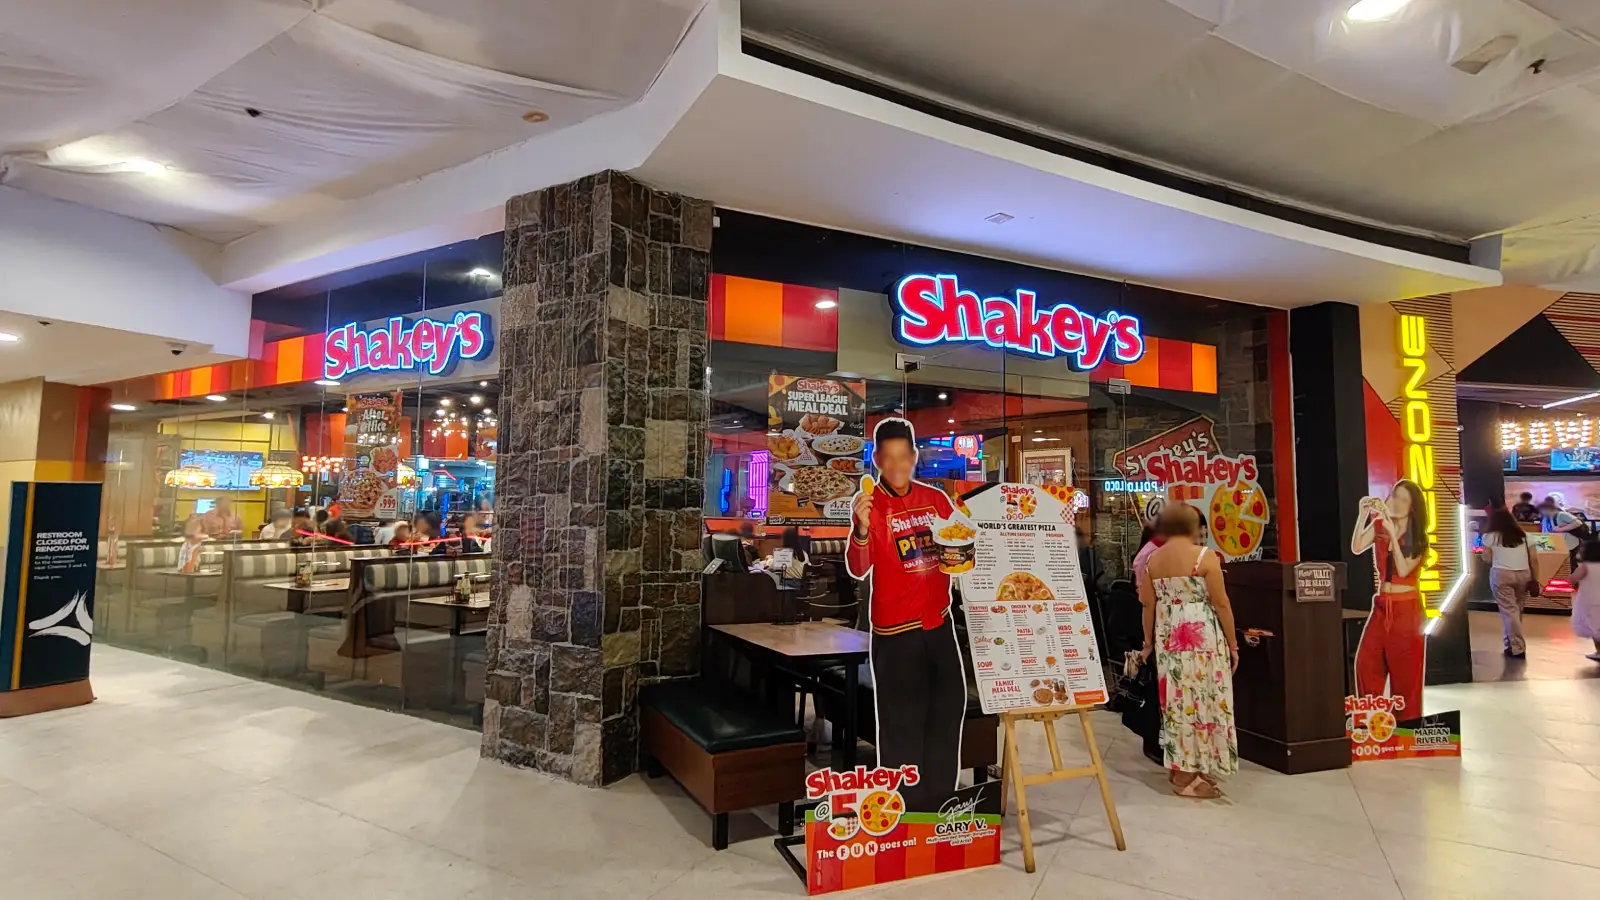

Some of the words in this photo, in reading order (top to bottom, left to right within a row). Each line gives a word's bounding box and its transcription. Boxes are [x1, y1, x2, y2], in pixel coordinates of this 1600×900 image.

[897, 274, 1143, 369] Shakey's
[324, 311, 484, 380] Shakey's
[797, 380, 840, 394] Shakey's
[787, 390, 815, 402] SUPER
[816, 393, 848, 404] LEAGUE
[787, 400, 819, 413] MEAL
[820, 402, 848, 415] DEAL
[1144, 453, 1258, 489] Shakey's
[1000, 485, 1035, 499] Shakey's
[977, 522, 1007, 530] WORLD'S
[1008, 523, 1037, 531] GREATEST
[1038, 524, 1056, 532] PIZZA
[1312, 569, 1330, 578] WAIT
[1414, 728, 1450, 736] MARIAN
[1416, 736, 1447, 744] RIVERA
[805, 764, 920, 800] Shakey's
[974, 819, 987, 829] V.
[816, 849, 834, 860] The
[836, 840, 879, 861] FUN
[880, 842, 901, 852] goes
[902, 836, 917, 847] on!
